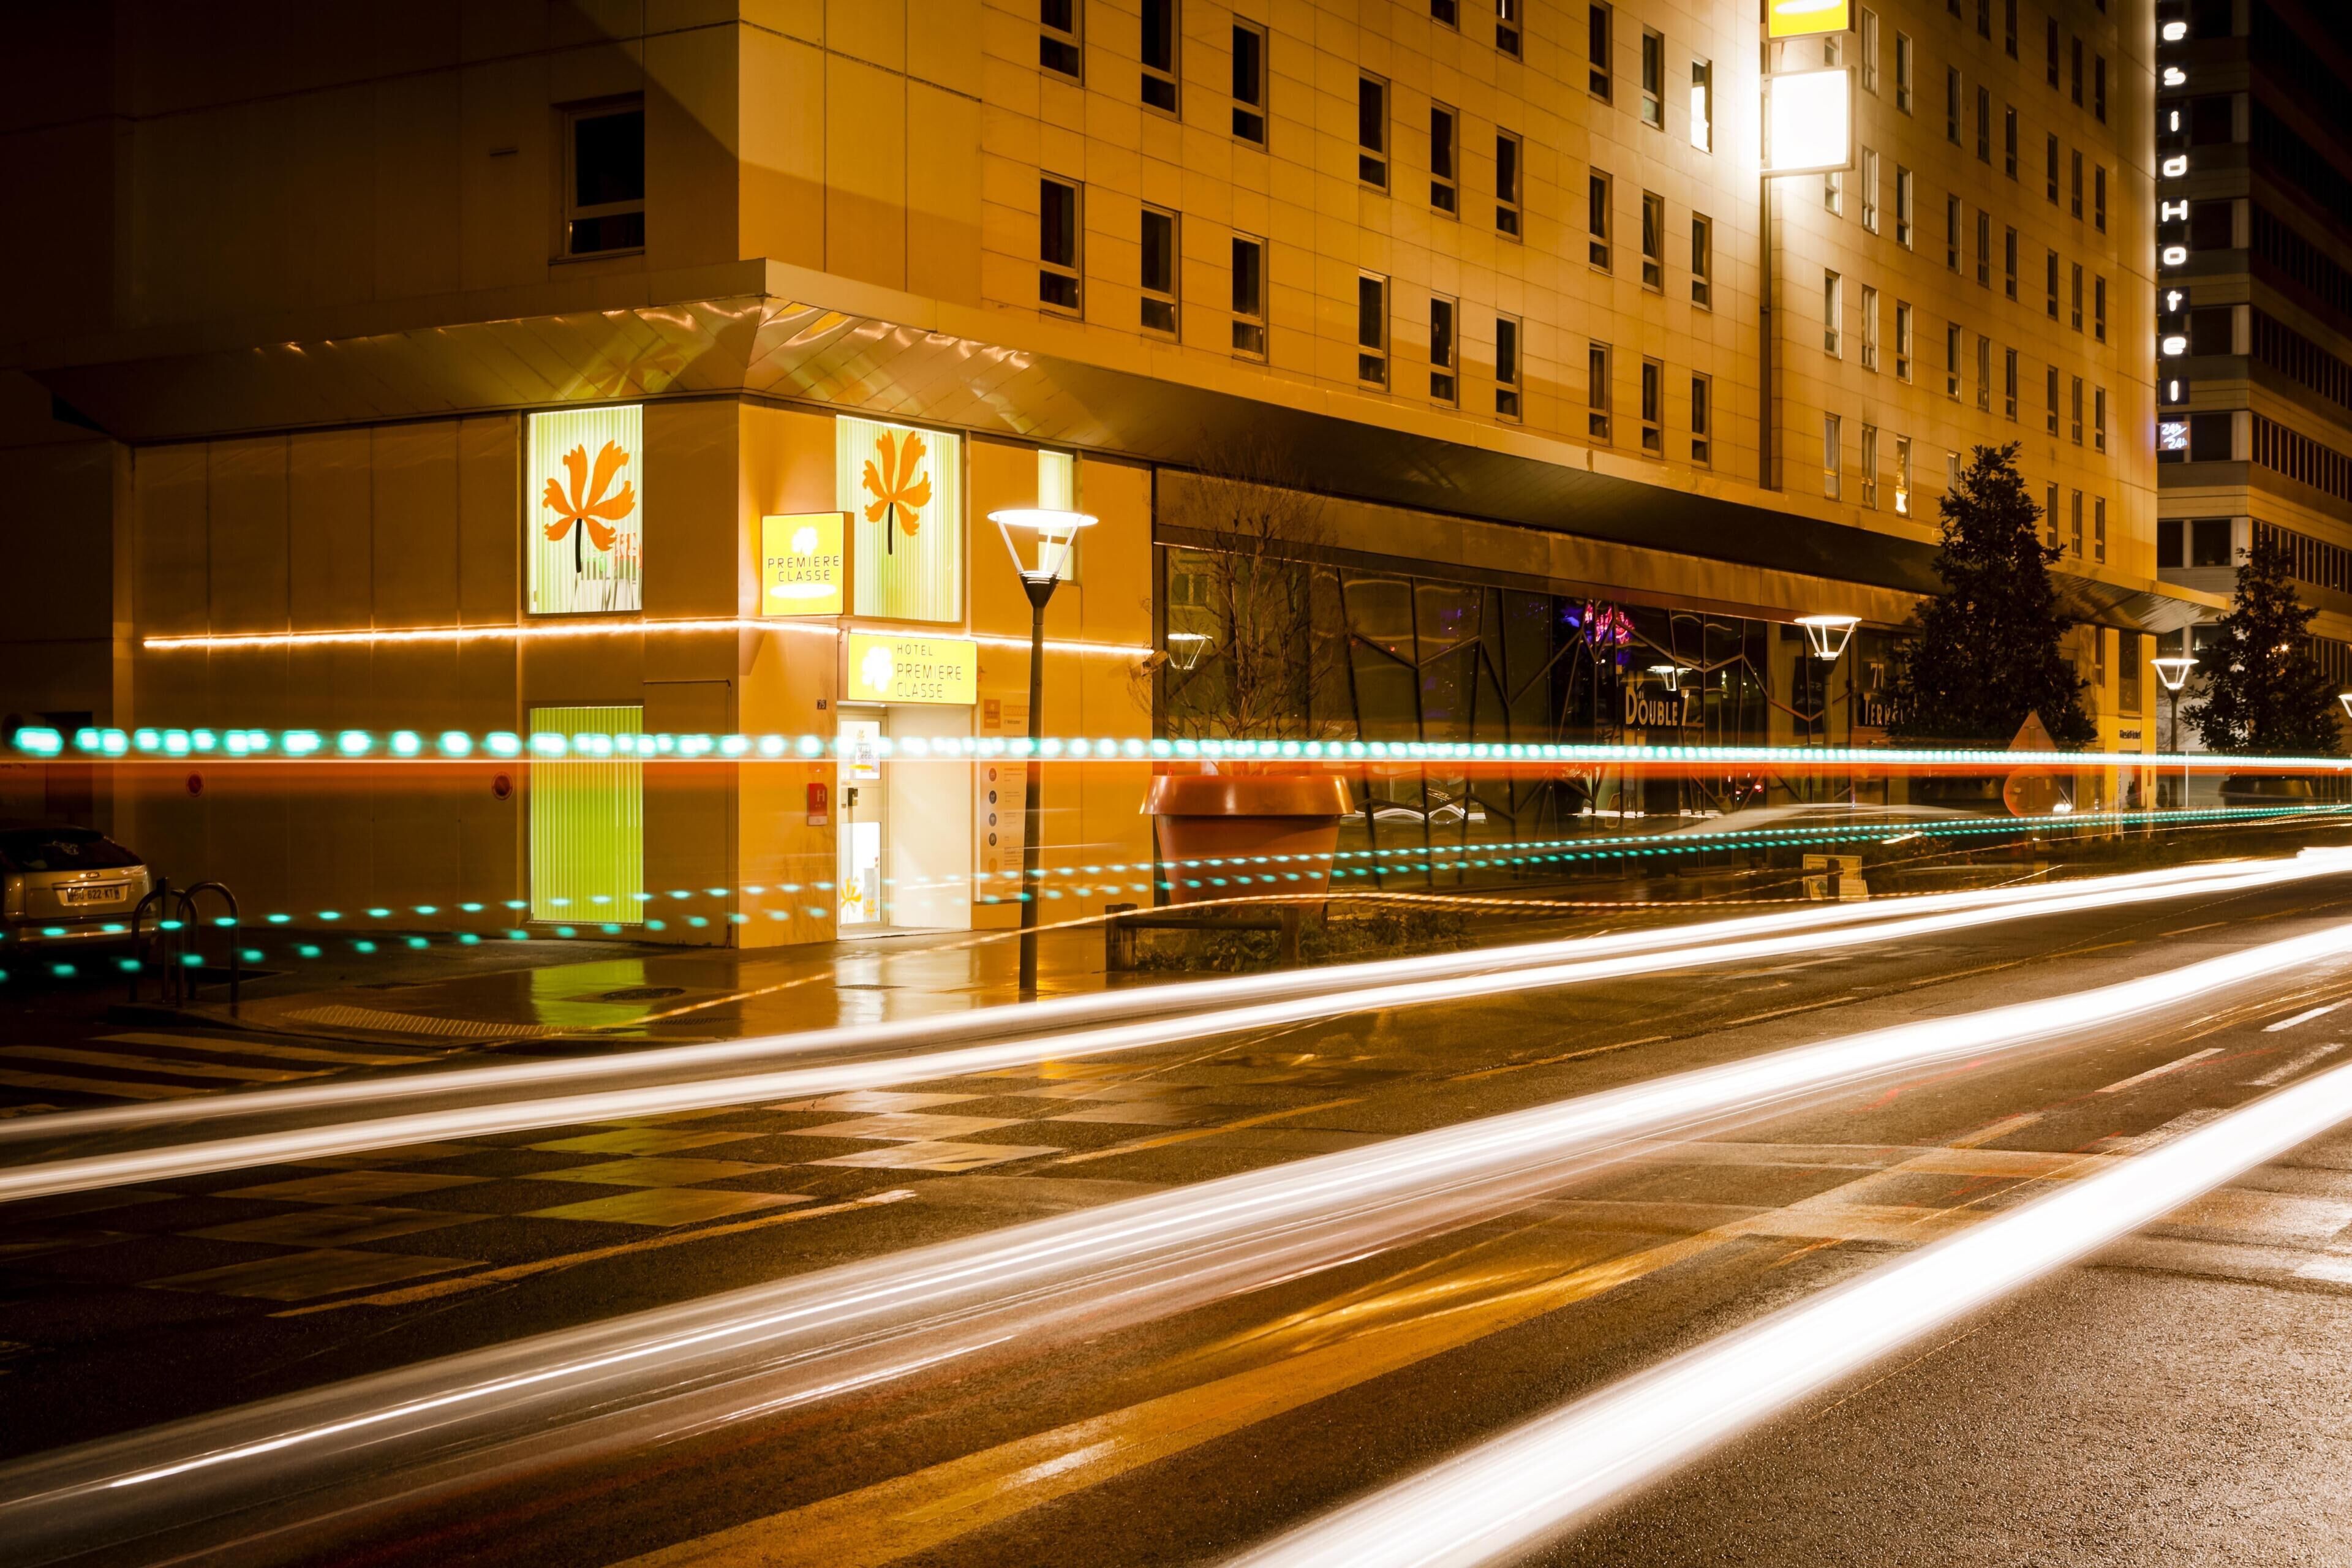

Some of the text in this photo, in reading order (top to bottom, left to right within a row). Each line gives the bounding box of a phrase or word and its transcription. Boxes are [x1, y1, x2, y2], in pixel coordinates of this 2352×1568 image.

[767, 556, 839, 568] PREMIERE
[778, 570, 830, 582] CLASSE
[897, 644, 933, 656] HOTEL
[897, 663, 961, 680] PREMIERE
[897, 682, 943, 698] CLASSE
